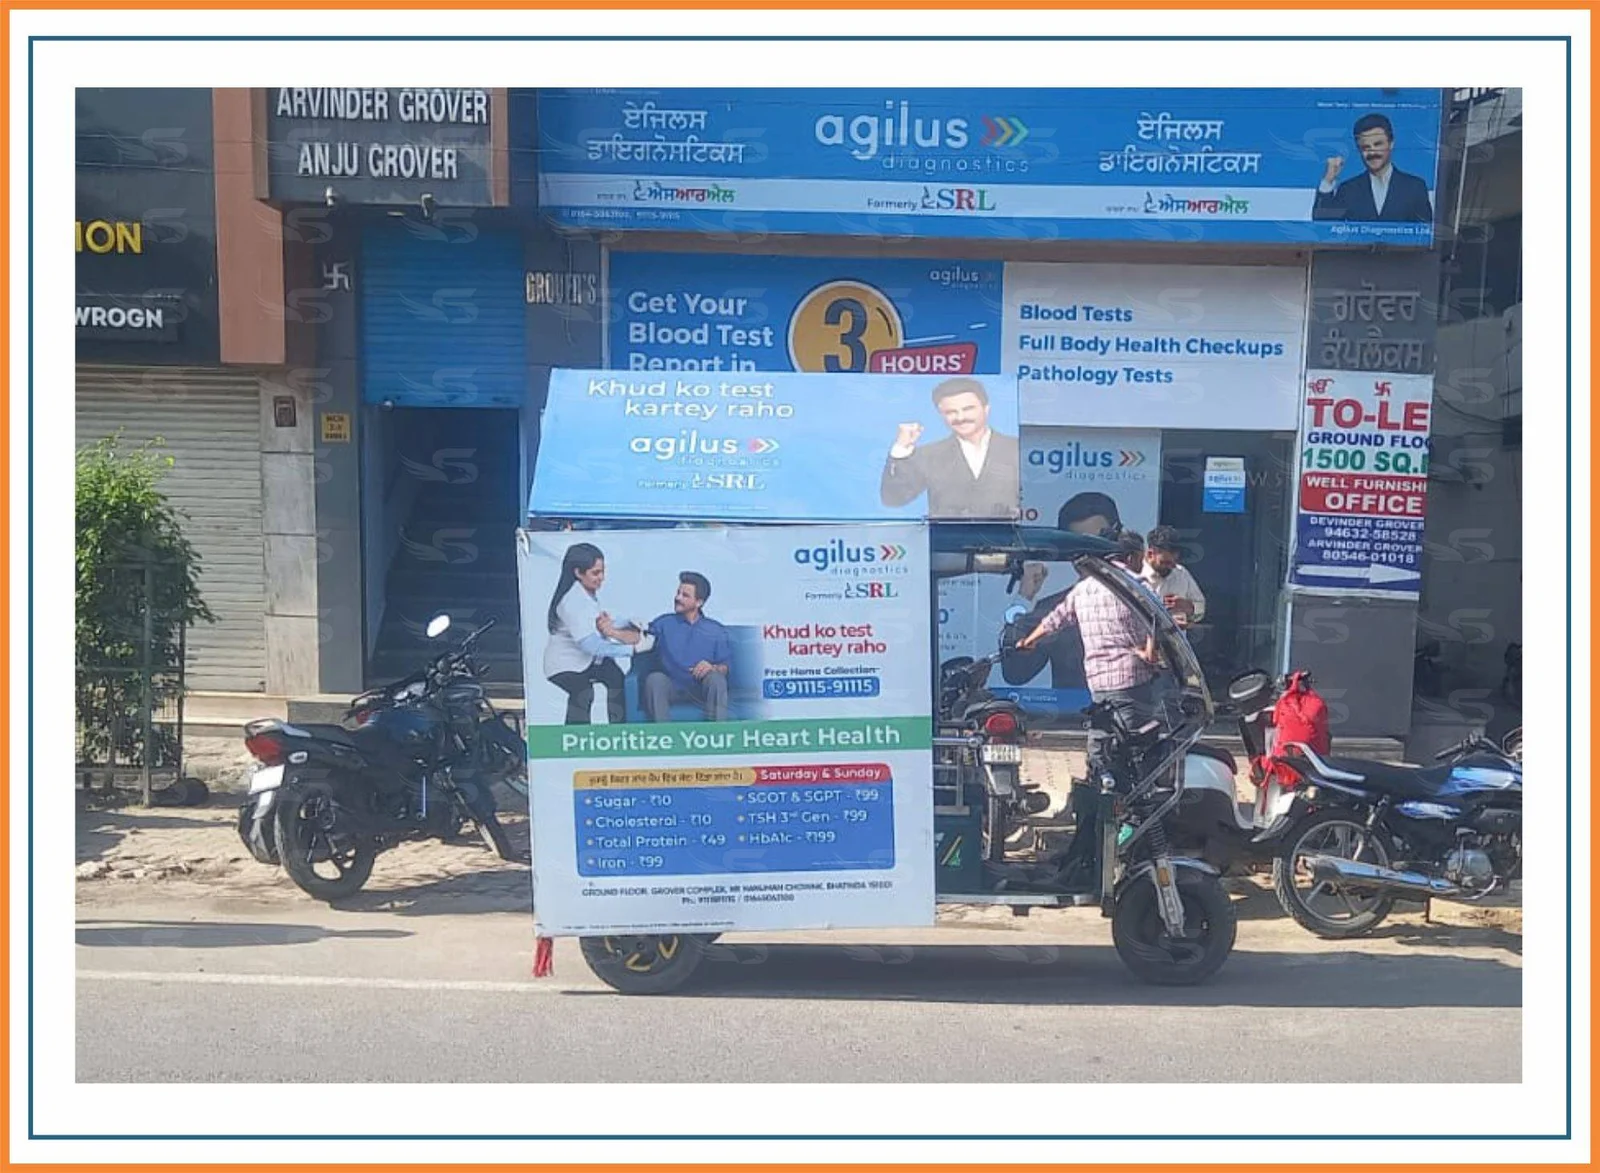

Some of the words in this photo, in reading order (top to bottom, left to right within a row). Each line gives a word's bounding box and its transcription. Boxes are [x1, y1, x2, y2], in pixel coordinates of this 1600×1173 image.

[277, 87, 388, 120] ARVINDER
[399, 88, 488, 124] GROVER
[815, 100, 969, 160] agilus
[298, 142, 359, 176] ANJU
[368, 144, 458, 179] GROVER
[883, 154, 1030, 175] diagnostics
[867, 198, 918, 211] Formerly
[937, 188, 996, 211] SRL
[929, 267, 979, 285] agilus
[628, 291, 677, 314] Get
[683, 293, 748, 316] Your
[1019, 304, 1078, 321] Blood
[1082, 306, 1133, 322] Tests
[75, 306, 163, 329] WROGN
[628, 322, 709, 345] Blood
[716, 324, 774, 347] Test
[824, 298, 868, 373] 3
[1018, 334, 1055, 351] Full
[1060, 336, 1110, 356] Body
[1115, 337, 1181, 354] Health
[1185, 338, 1284, 358] Checkups
[1017, 365, 1118, 386] Pathology
[1122, 367, 1173, 384] Tests
[587, 379, 667, 397] Khud
[675, 381, 711, 397] ko
[719, 382, 775, 398] test
[624, 400, 718, 421] kartey
[728, 402, 794, 418] raho
[629, 430, 739, 460] agilus
[1307, 431, 1385, 447] GROUND
[1028, 442, 1113, 473] agilus
[1303, 448, 1366, 471] 1500
[1306, 475, 1349, 489] WELL
[1354, 478, 1427, 492] FURNISH
[1325, 492, 1423, 515] OFFICE
[794, 539, 876, 571] agilus
[856, 582, 898, 599] SRL
[763, 623, 810, 640] Khud
[815, 623, 836, 638] ko
[841, 623, 873, 638] test
[788, 641, 843, 658] kartey
[847, 639, 887, 654] raho
[764, 668, 787, 676] Free
[785, 679, 873, 694] 91115-91115
[562, 731, 672, 752] Prioritize
[680, 730, 735, 750] Your
[742, 728, 811, 748] Heart
[818, 725, 901, 746] Health
[760, 767, 818, 781] Saturday
[834, 767, 882, 780] Sunday
[594, 795, 637, 810] Sugar
[747, 791, 788, 804] SGOT
[804, 790, 843, 802] SGPT
[855, 789, 879, 801] ₹99
[595, 815, 678, 829] Cholesterol
[747, 812, 777, 824] TSH
[801, 811, 831, 823] Gen
[843, 810, 868, 822] ₹99
[596, 835, 633, 849] Total
[635, 834, 688, 848] Protein
[598, 857, 626, 869] Iron
